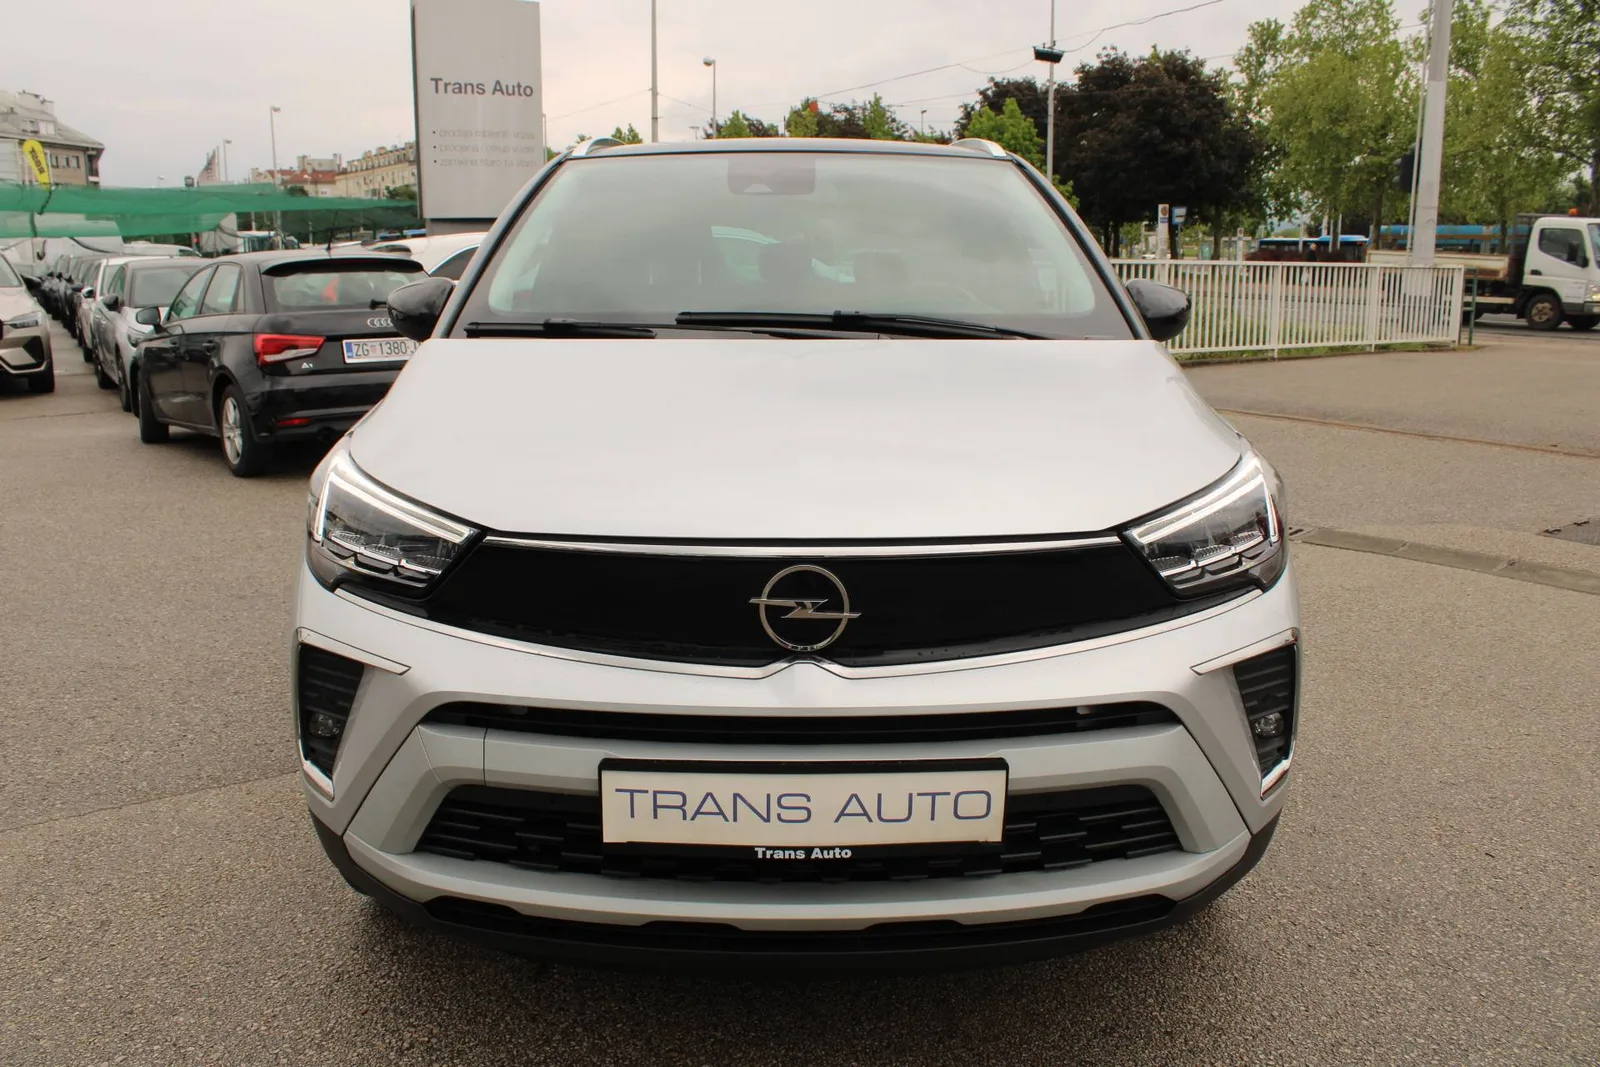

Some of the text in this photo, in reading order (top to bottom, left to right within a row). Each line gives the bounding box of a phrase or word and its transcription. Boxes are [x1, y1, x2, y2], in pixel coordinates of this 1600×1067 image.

[430, 77, 534, 97] Trans Auto
[353, 340, 420, 357] ZG 1380-J
[614, 788, 993, 824] TRANS AUTO
[754, 847, 852, 859] Trans Auto
